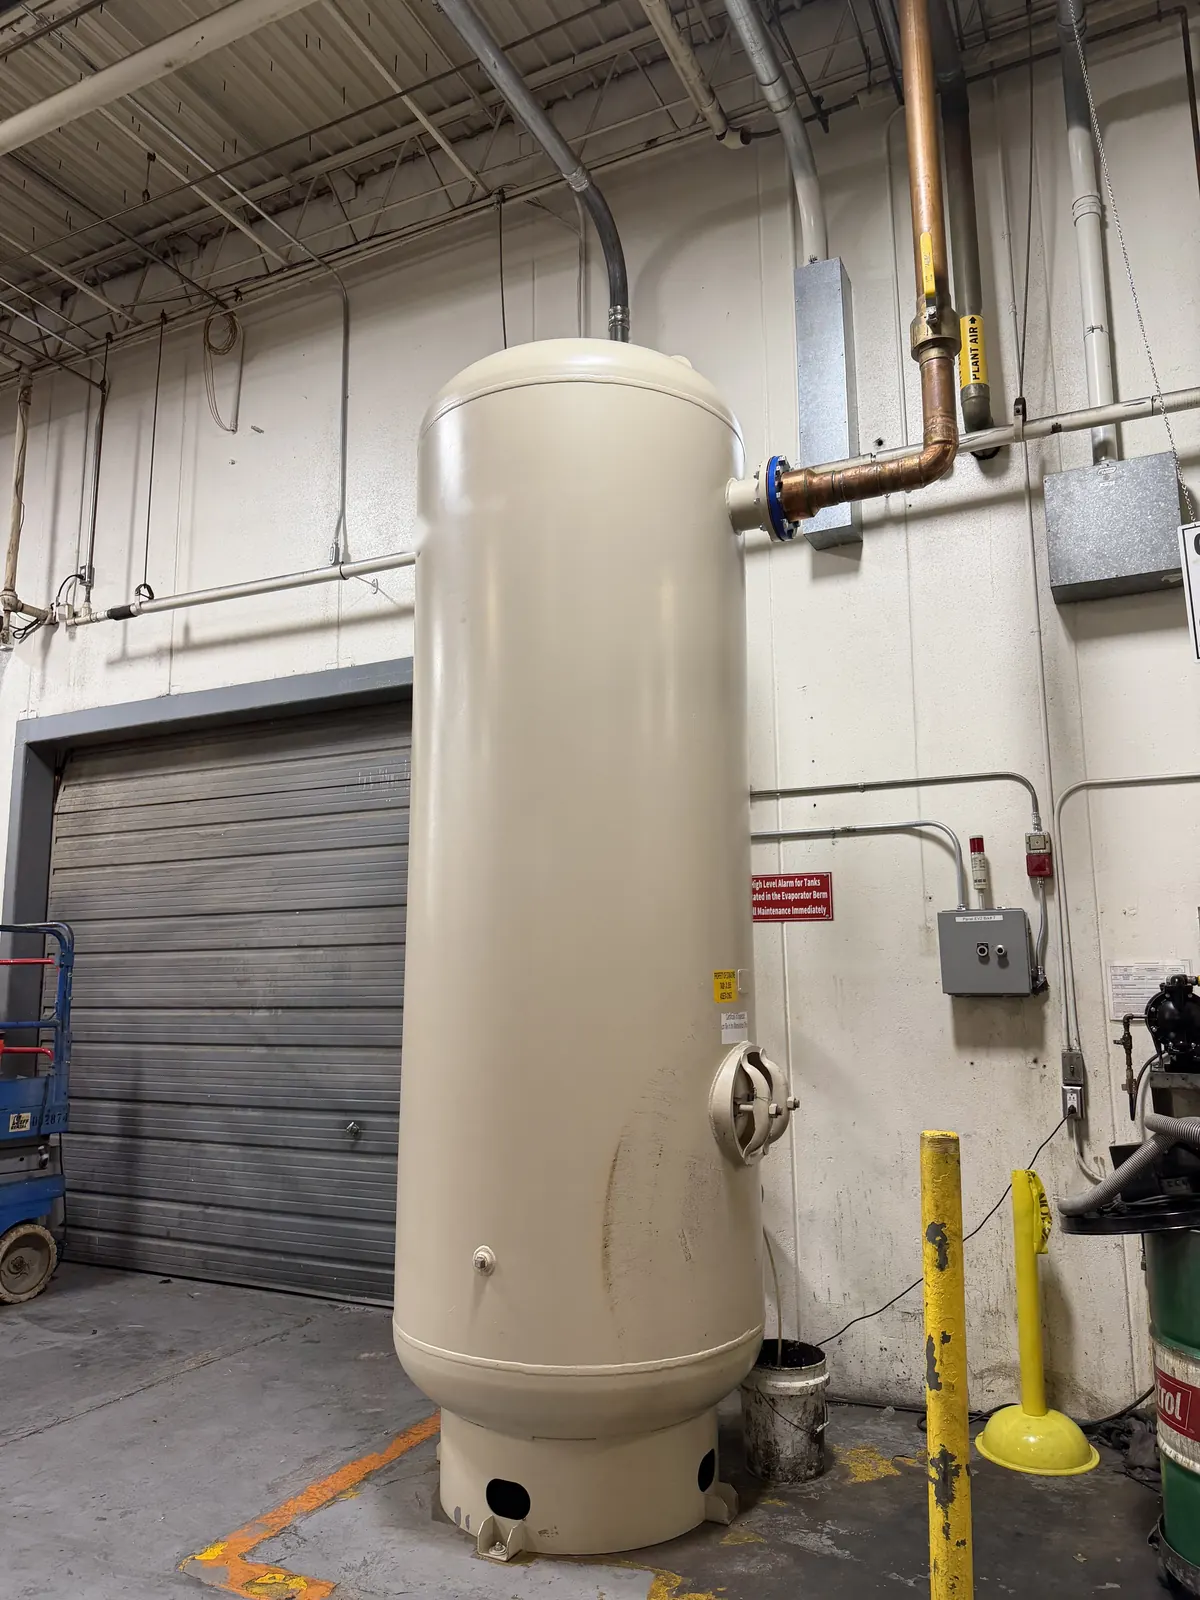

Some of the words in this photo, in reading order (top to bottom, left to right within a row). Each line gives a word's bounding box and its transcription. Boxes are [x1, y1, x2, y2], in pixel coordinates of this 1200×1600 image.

[968, 327, 978, 344] AIR
[970, 348, 980, 380] PLANT
[763, 880, 777, 888] Level
[778, 879, 794, 888] Alarm
[804, 877, 820, 886] Tanks
[752, 892, 764, 900] ated
[766, 892, 771, 900] in
[772, 891, 780, 900] the
[782, 891, 812, 901] Evaporator
[812, 890, 828, 899] Berm
[757, 906, 790, 916] Maintenance
[792, 905, 826, 916] Immediately
[1158, 1379, 1182, 1420] trol
